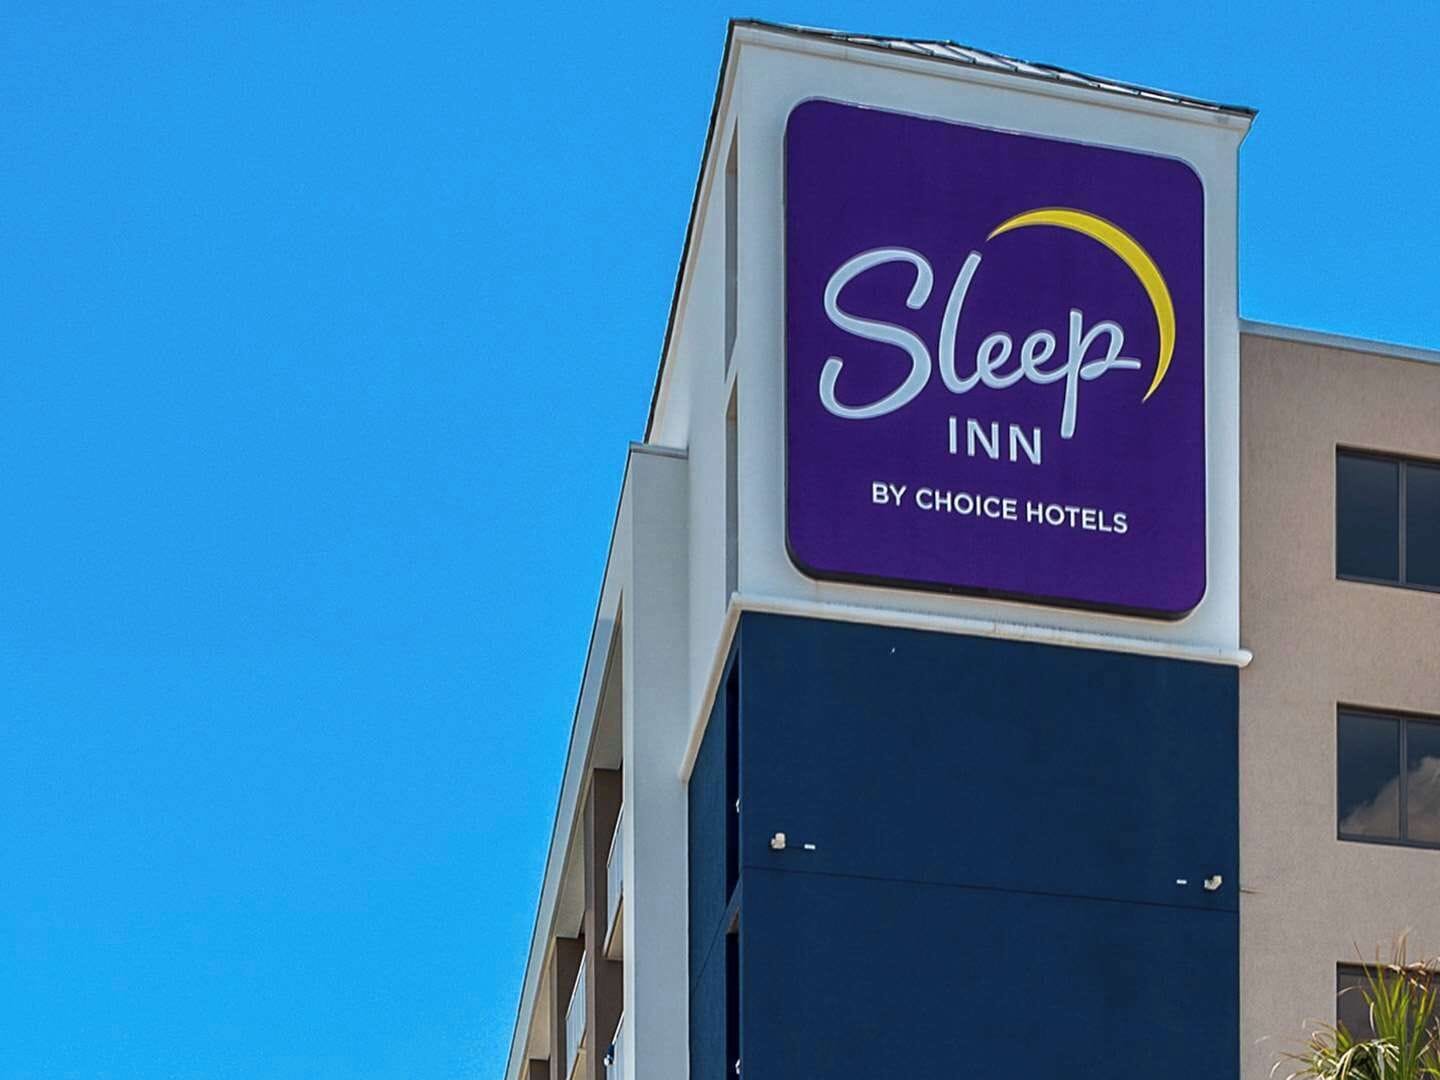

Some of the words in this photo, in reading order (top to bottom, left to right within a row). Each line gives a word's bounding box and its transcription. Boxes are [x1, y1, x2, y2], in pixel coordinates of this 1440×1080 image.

[819, 246, 1141, 438] Sleep
[949, 416, 1041, 465] INN
[872, 481, 906, 506] BY
[915, 487, 1018, 521] CHOICE
[1026, 501, 1128, 534] HOTELS
